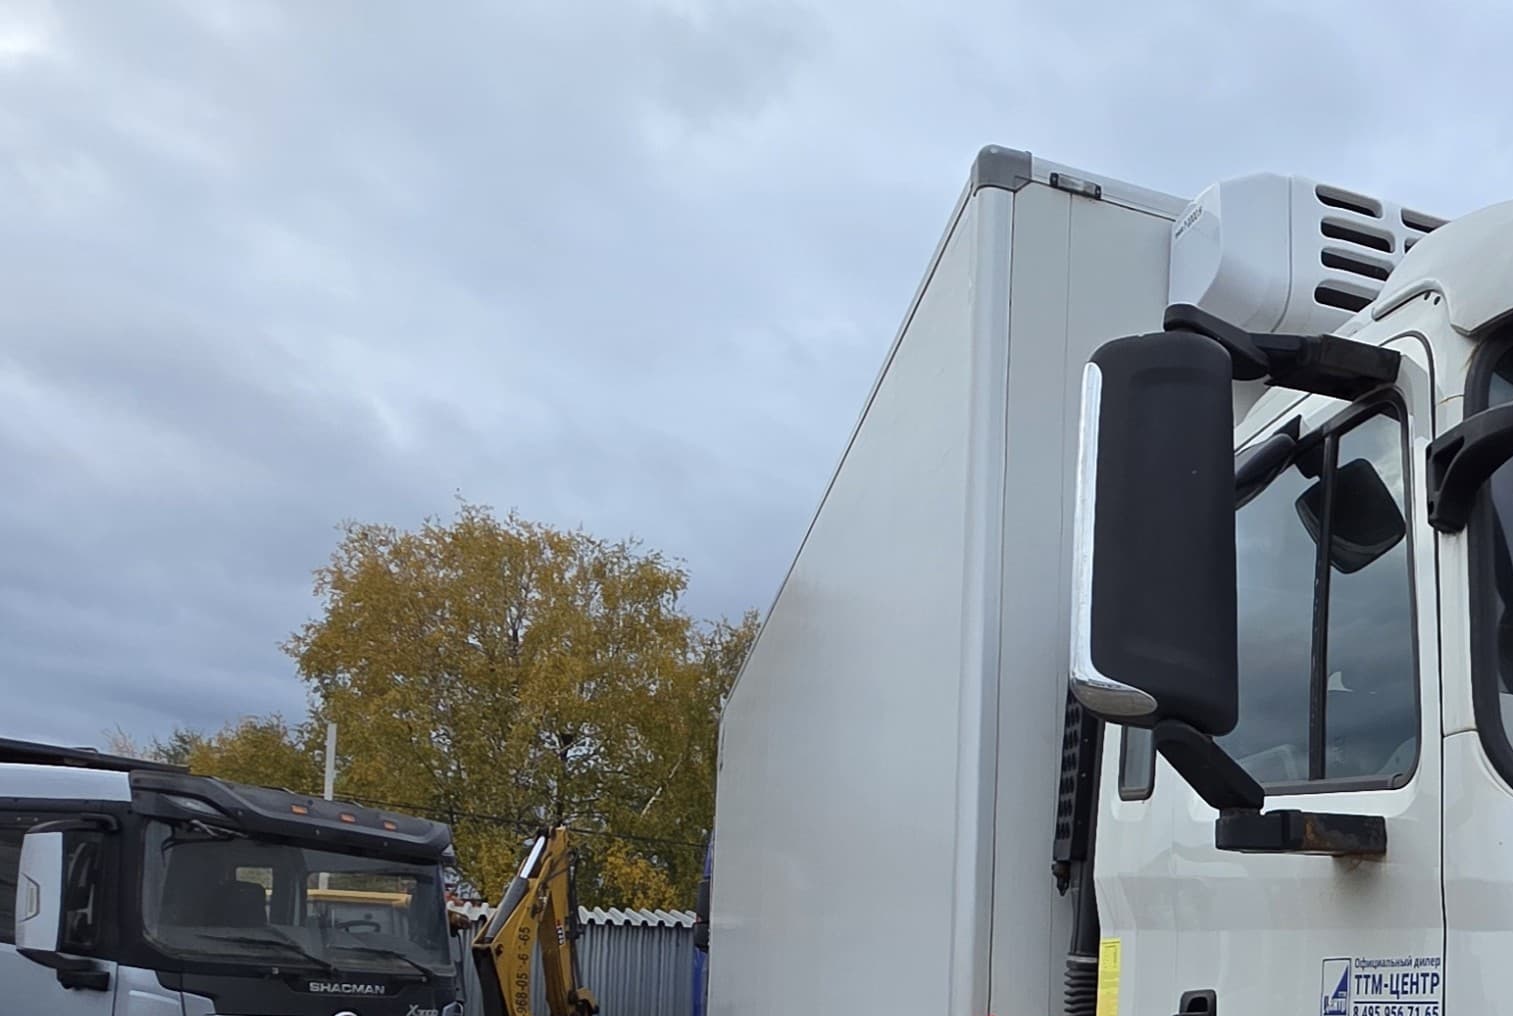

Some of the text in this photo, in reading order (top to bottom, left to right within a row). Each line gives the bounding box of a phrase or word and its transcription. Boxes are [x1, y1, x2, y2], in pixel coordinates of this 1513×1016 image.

[1354, 956, 1441, 971] Официальный дилер
[308, 981, 386, 995] SHACMAN
[1354, 972, 1441, 1000] ТТМ-ЦЕНТР
